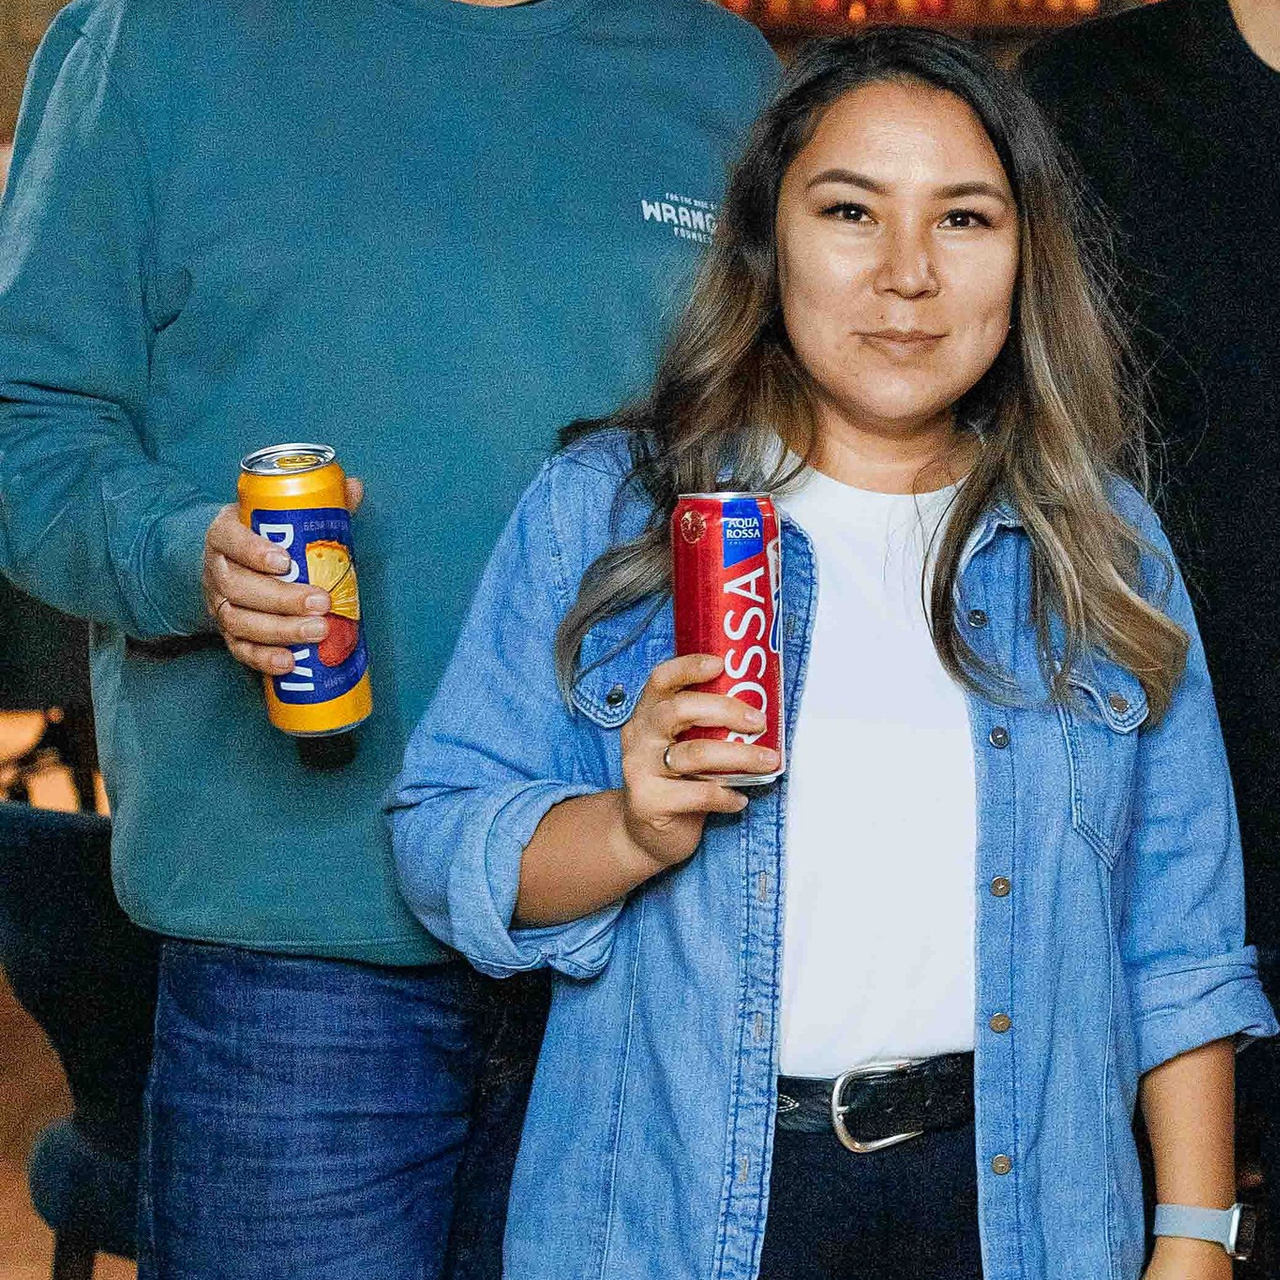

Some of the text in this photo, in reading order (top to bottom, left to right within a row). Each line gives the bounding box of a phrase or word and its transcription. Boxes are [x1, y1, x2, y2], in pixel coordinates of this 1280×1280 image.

[641, 199, 716, 234] WRANG
[728, 517, 760, 529] AQUA
[726, 529, 761, 539] ROSSA
